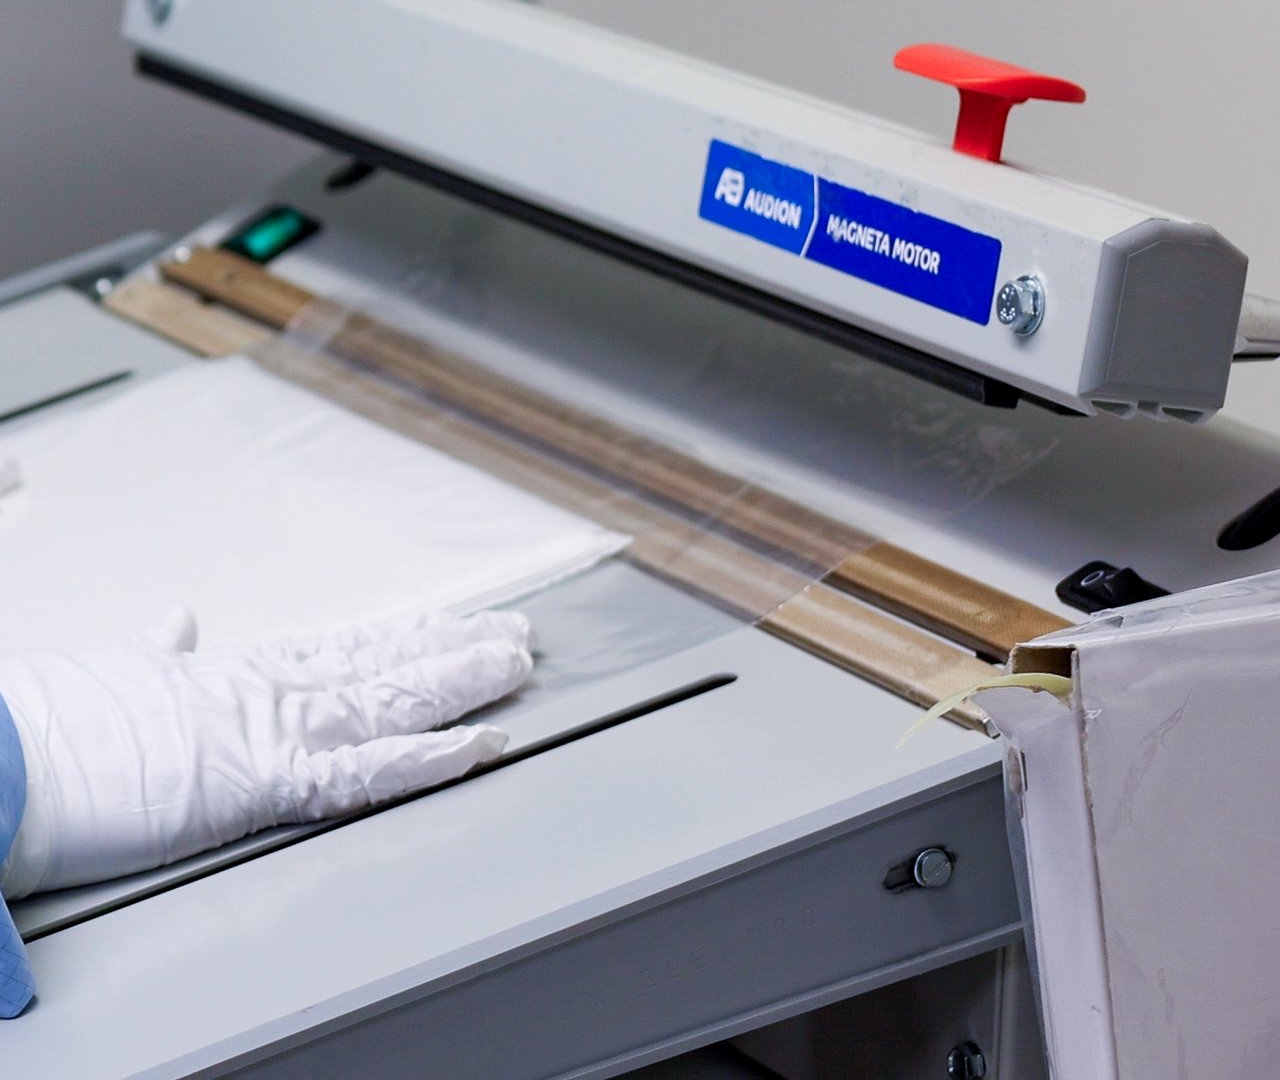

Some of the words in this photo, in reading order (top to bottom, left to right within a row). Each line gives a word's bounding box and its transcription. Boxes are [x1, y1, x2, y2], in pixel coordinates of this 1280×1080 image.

[743, 187, 802, 230] AUDION
[826, 214, 890, 257] MAGNETA
[892, 238, 940, 275] MOTOR
